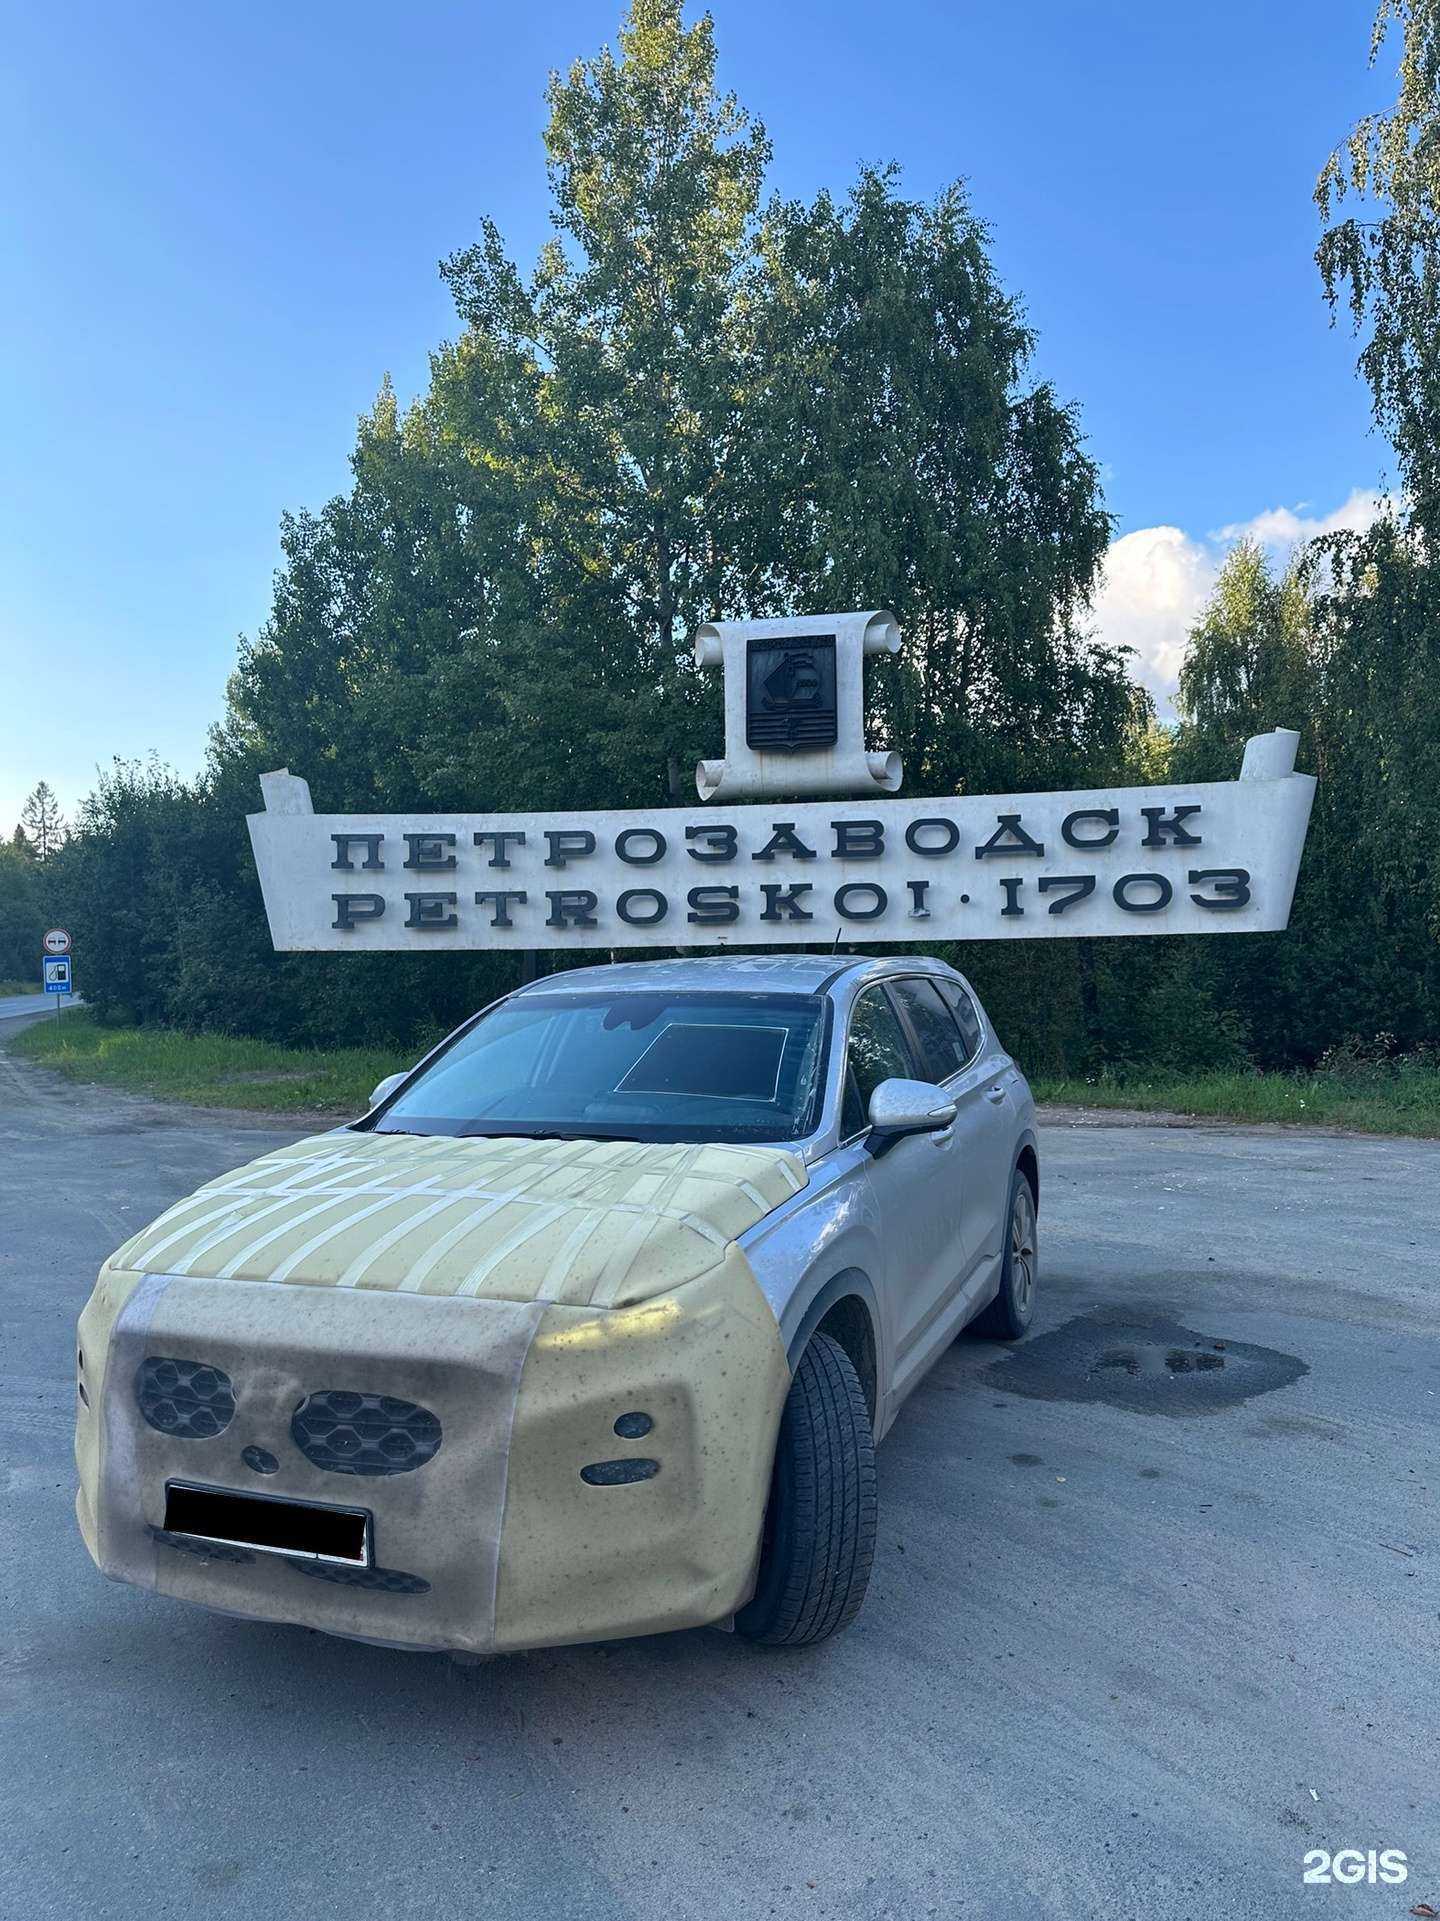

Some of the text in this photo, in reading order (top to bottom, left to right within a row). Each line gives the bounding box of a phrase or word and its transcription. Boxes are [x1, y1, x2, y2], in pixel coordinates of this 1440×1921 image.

[330, 805, 1202, 869] ПЕТРОЗАВОДСК
[330, 868, 1252, 930] PETROSKOI 1703
